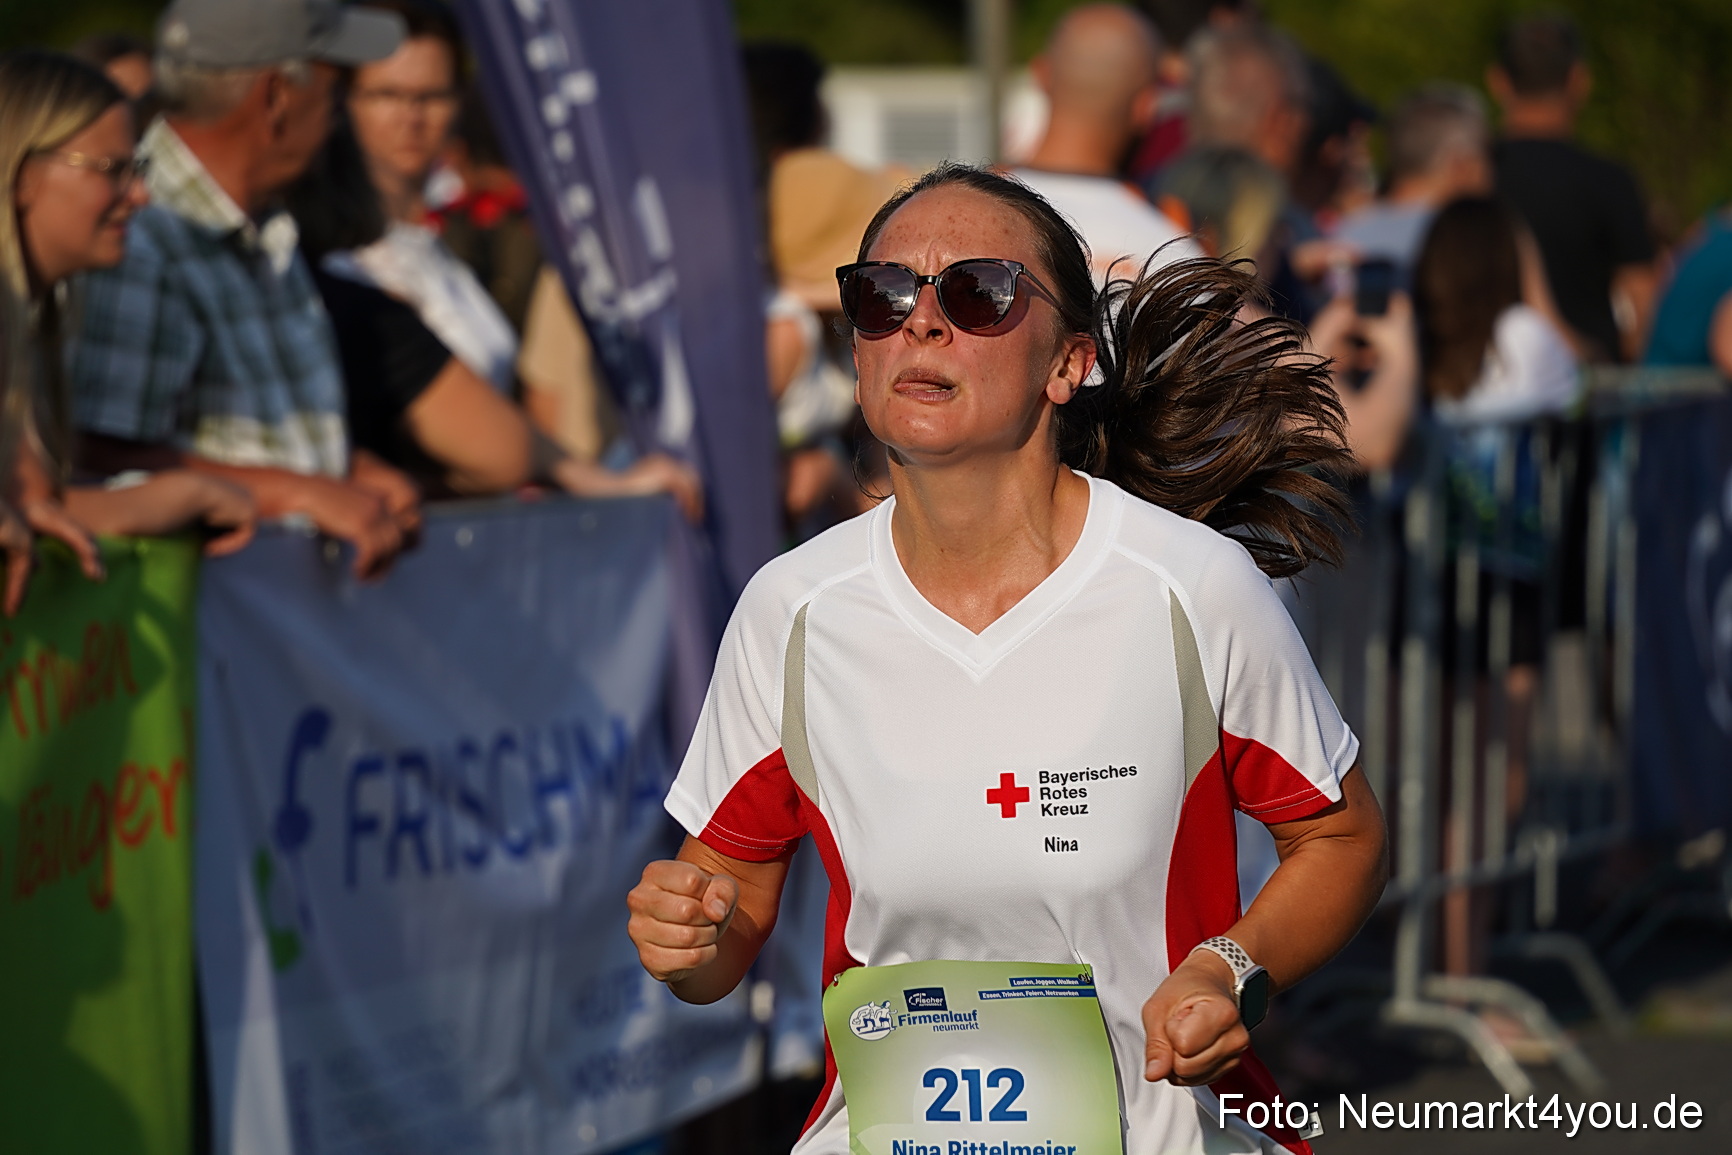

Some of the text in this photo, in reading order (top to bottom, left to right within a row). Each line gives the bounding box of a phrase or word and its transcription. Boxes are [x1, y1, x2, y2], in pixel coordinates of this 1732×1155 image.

[1039, 765, 1138, 786] Bayerisches
[1039, 787, 1088, 801] Rotes
[1041, 803, 1089, 817] Kreuz
[1044, 836, 1079, 853] Nina
[1013, 979, 1036, 987] Laufen,
[1035, 979, 1057, 987] Joggen,
[982, 991, 1002, 1000] Essen,
[1001, 990, 1026, 999] Trinken,
[898, 1009, 978, 1027] Firmenlauf
[932, 1021, 980, 1032] neumarkt
[922, 1067, 1028, 1122] 212
[892, 1140, 1077, 1155] Nina Rittelmeier
